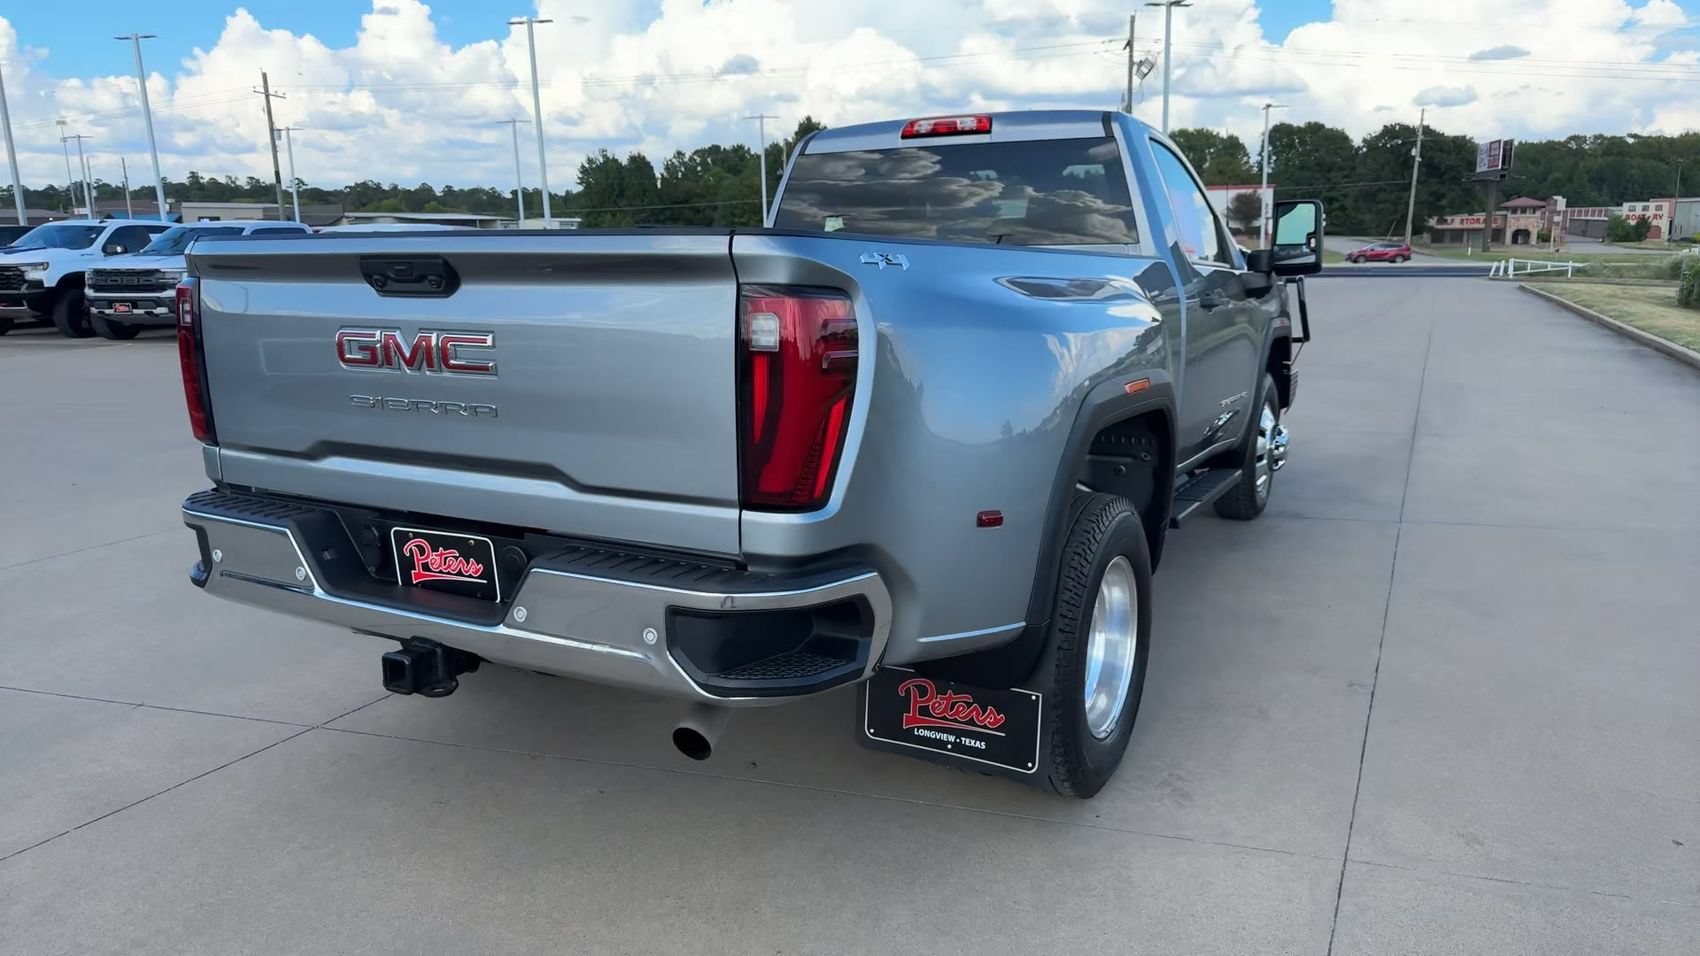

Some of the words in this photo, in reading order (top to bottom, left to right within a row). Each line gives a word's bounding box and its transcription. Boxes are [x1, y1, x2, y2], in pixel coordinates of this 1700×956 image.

[335, 326, 498, 380] GMC
[349, 394, 499, 418] SIERRA
[403, 538, 484, 581] Peters
[898, 677, 1006, 729] Peters
[914, 728, 956, 743] LONGVIEW
[961, 737, 986, 749] TEXAS
